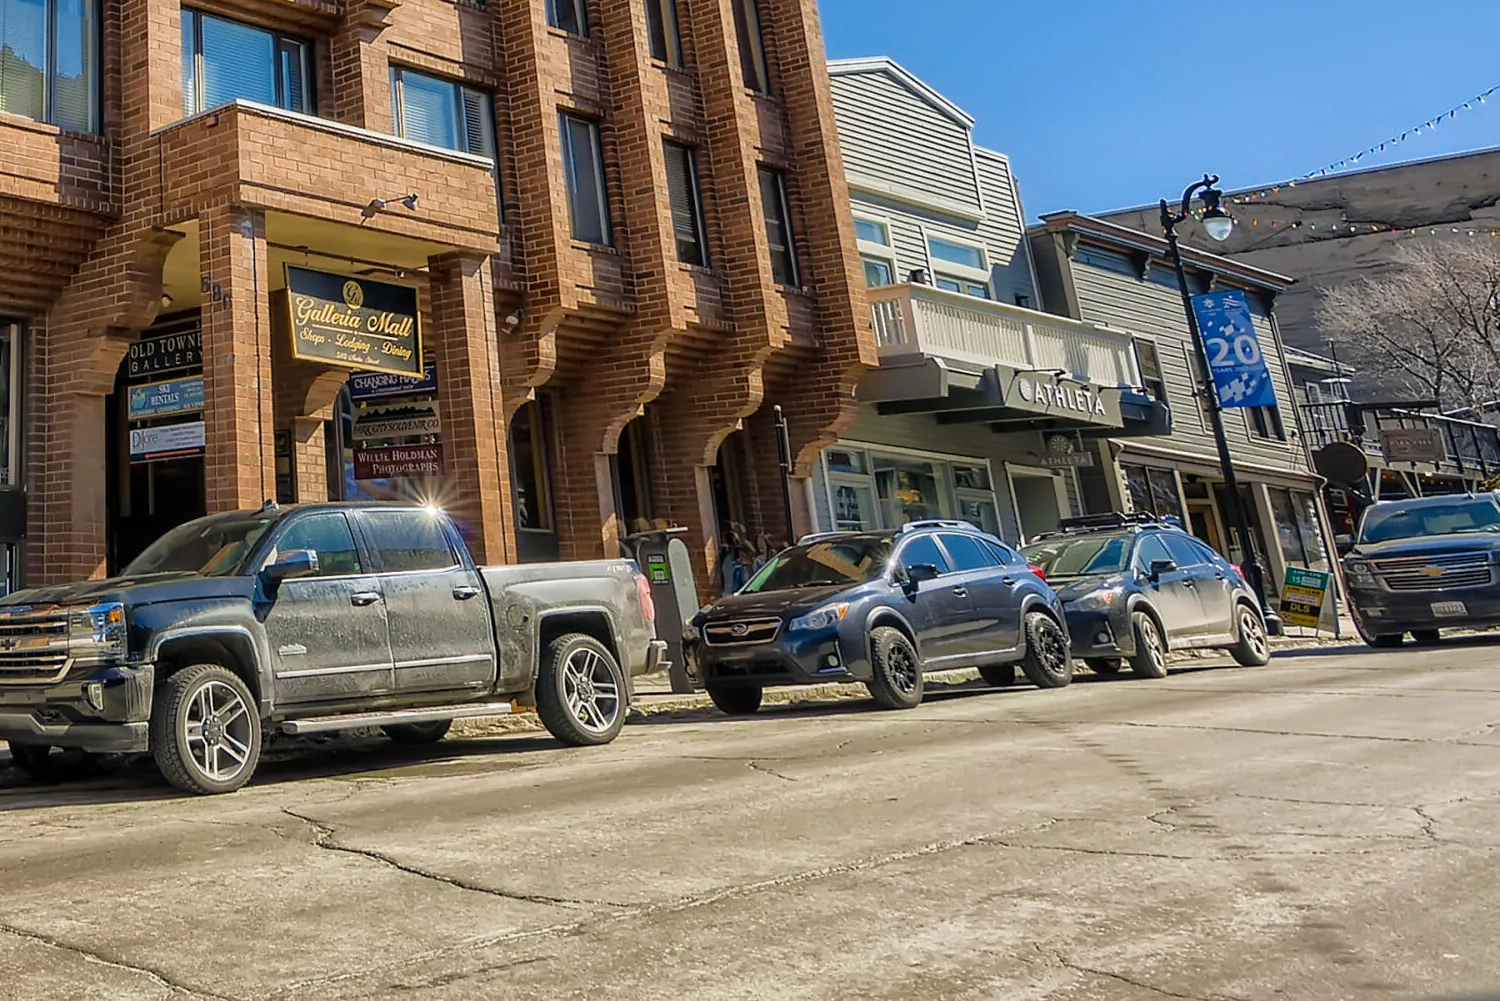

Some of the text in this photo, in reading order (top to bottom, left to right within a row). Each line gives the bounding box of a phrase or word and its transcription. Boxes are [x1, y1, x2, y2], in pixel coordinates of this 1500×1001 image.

[295, 298, 413, 337] Galleria Mall
[130, 342, 155, 359] OLD
[300, 327, 412, 360] Shops Lodging Dining
[1206, 334, 1260, 367] 20
[354, 375, 398, 389] CHANGING
[150, 392, 180, 406] RENTALS
[1035, 381, 1107, 416] ATHLETA
[358, 449, 437, 463] WILLIE HOLDMAN
[1040, 455, 1088, 466] ATHLETA
[372, 461, 439, 475] PHOTOGRAPHS
